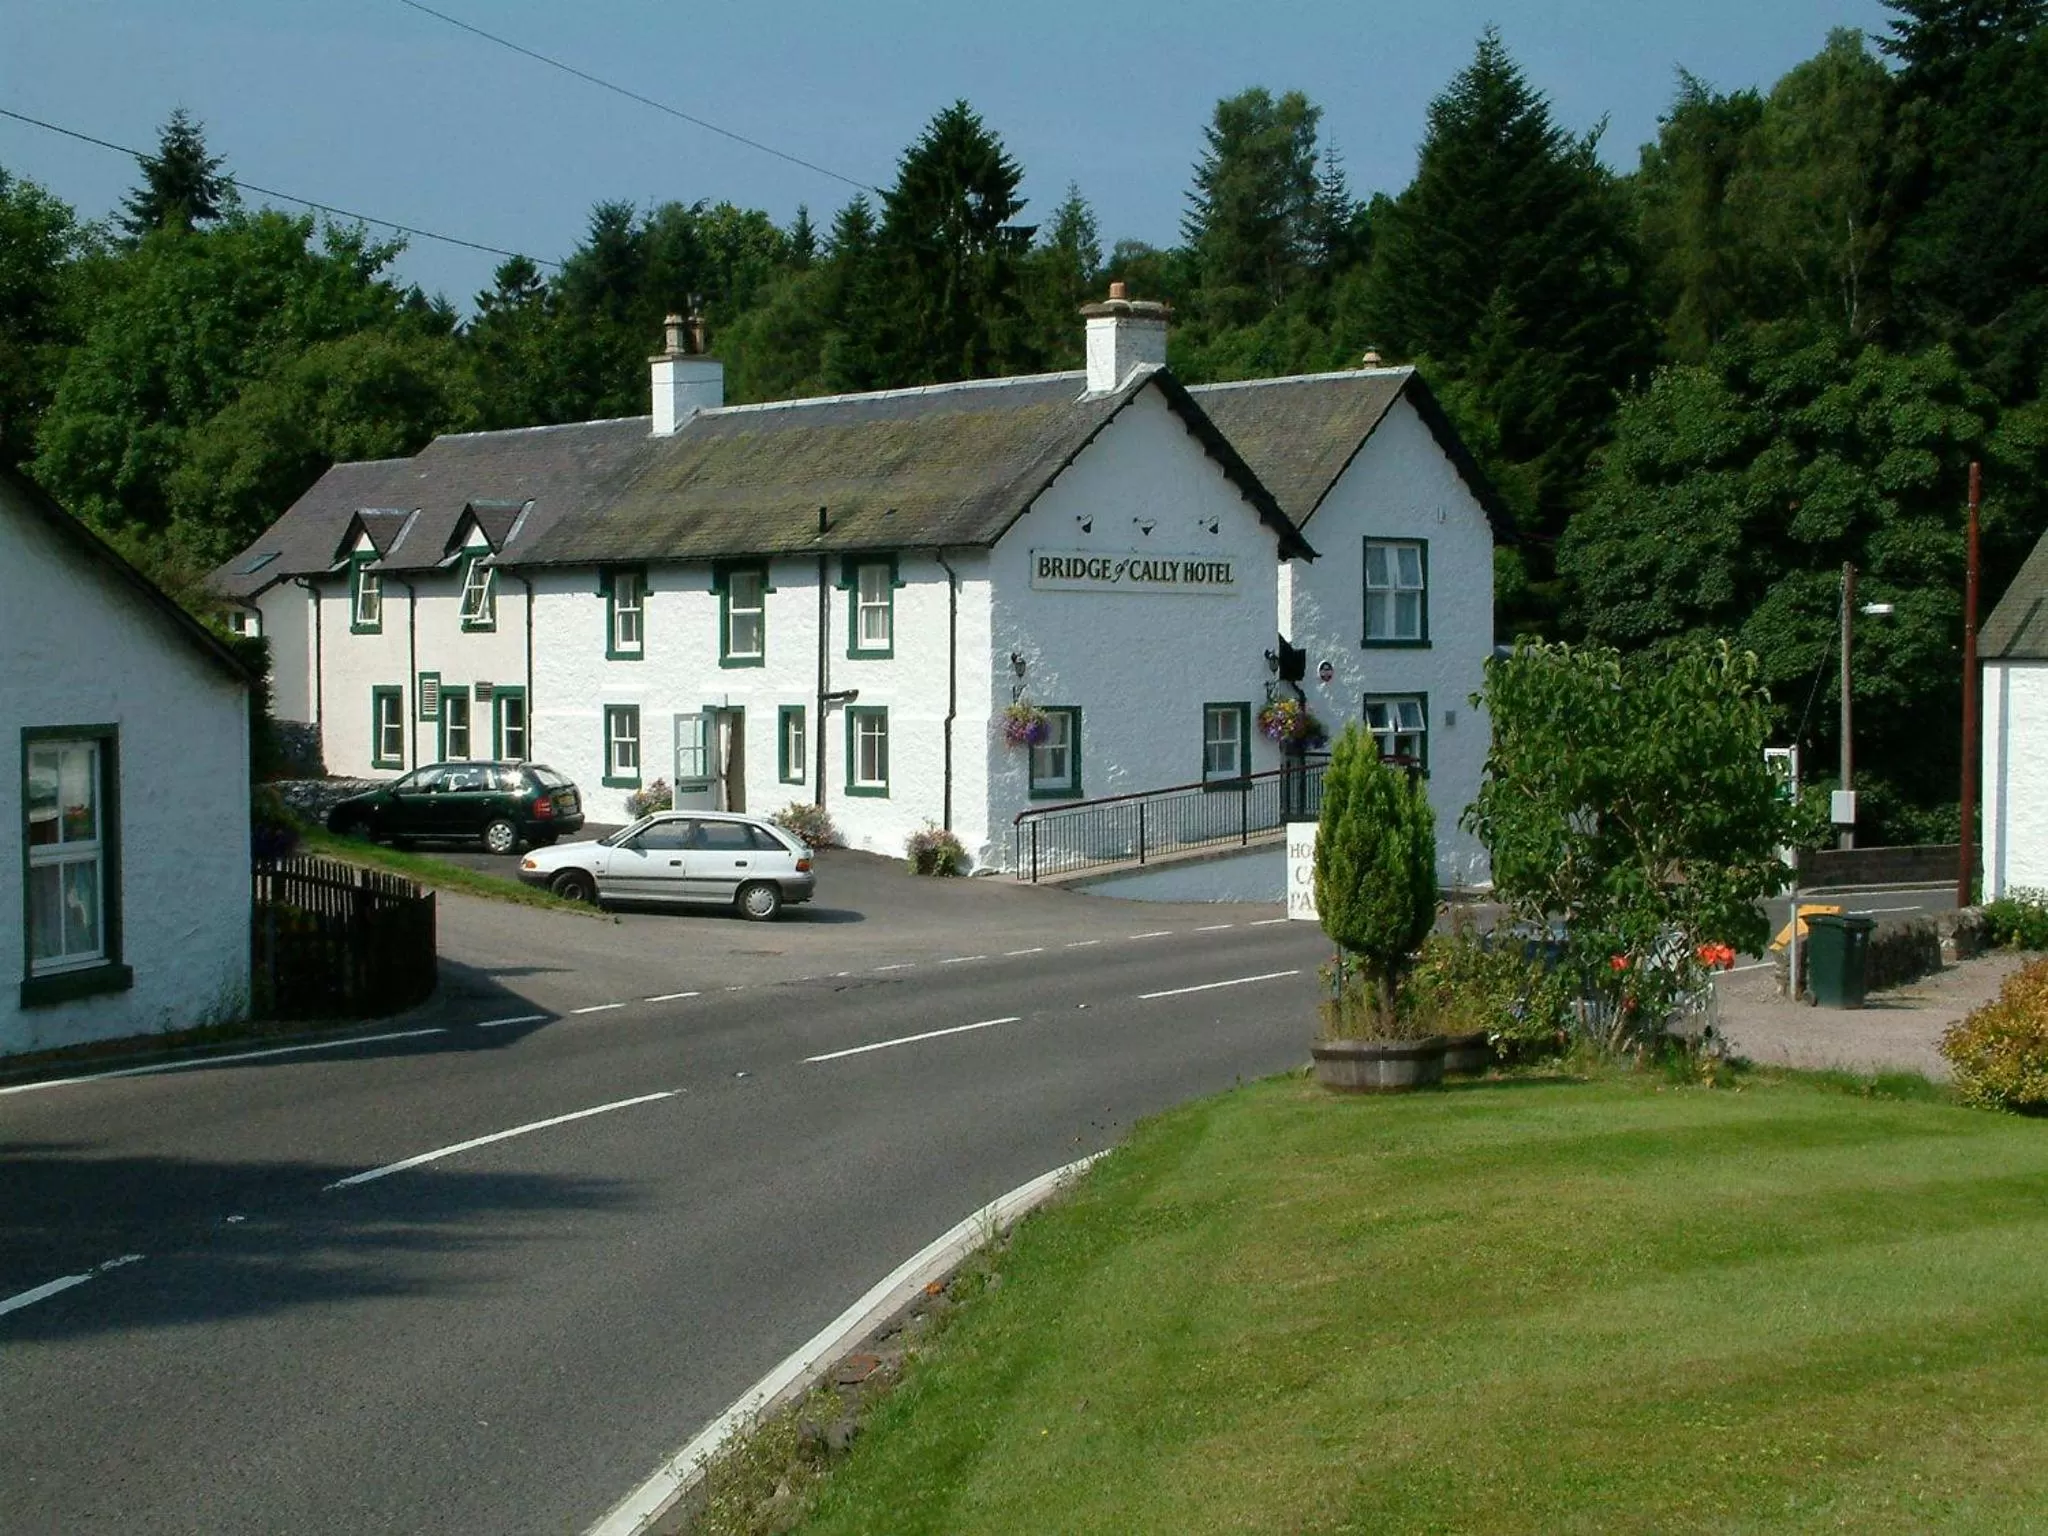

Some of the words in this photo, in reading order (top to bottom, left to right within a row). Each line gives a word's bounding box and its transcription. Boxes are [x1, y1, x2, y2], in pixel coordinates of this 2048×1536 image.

[1038, 556, 1112, 580] BRIDGE
[1129, 559, 1181, 583] CALLY
[1184, 561, 1234, 584] HOTEL
